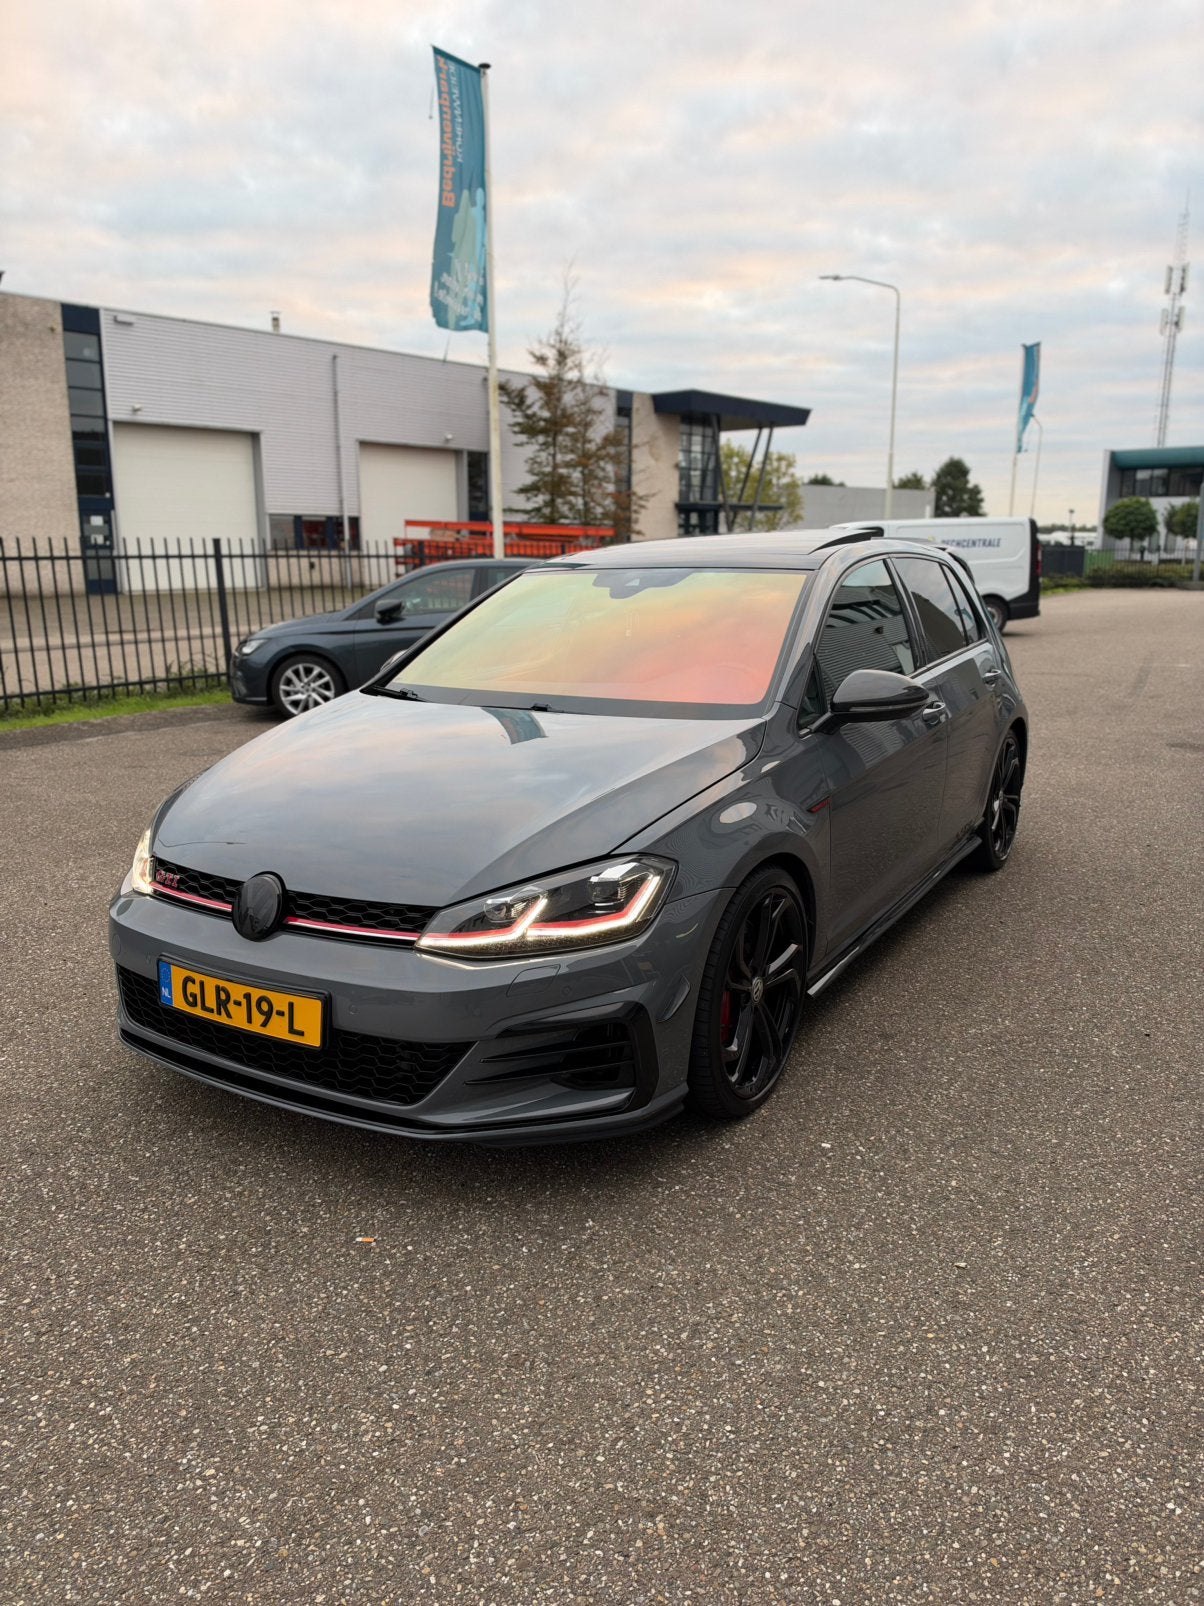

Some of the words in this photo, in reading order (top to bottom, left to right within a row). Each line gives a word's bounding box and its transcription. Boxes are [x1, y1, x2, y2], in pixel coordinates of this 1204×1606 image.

[156, 870, 180, 887] GTI
[161, 987, 171, 999] NL
[181, 975, 305, 1037] GLR-19-L
